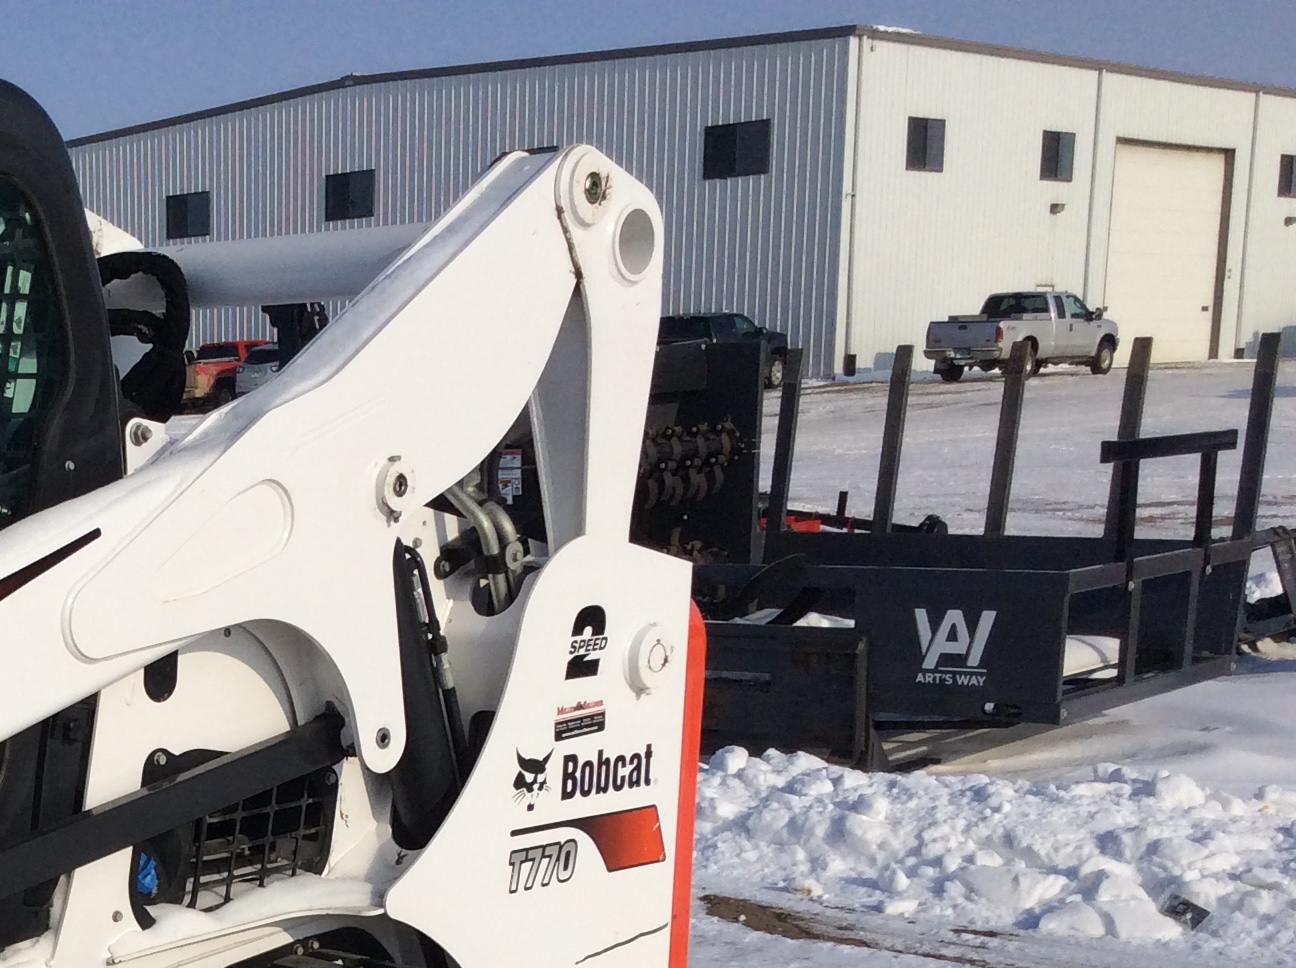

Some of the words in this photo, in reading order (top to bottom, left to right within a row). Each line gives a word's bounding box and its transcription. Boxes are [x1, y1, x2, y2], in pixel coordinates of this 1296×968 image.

[569, 636, 609, 655] SPEED
[915, 672, 953, 685] ART'S
[956, 674, 987, 687] WAY
[560, 743, 653, 801] Bobcat
[508, 838, 579, 895] T770
